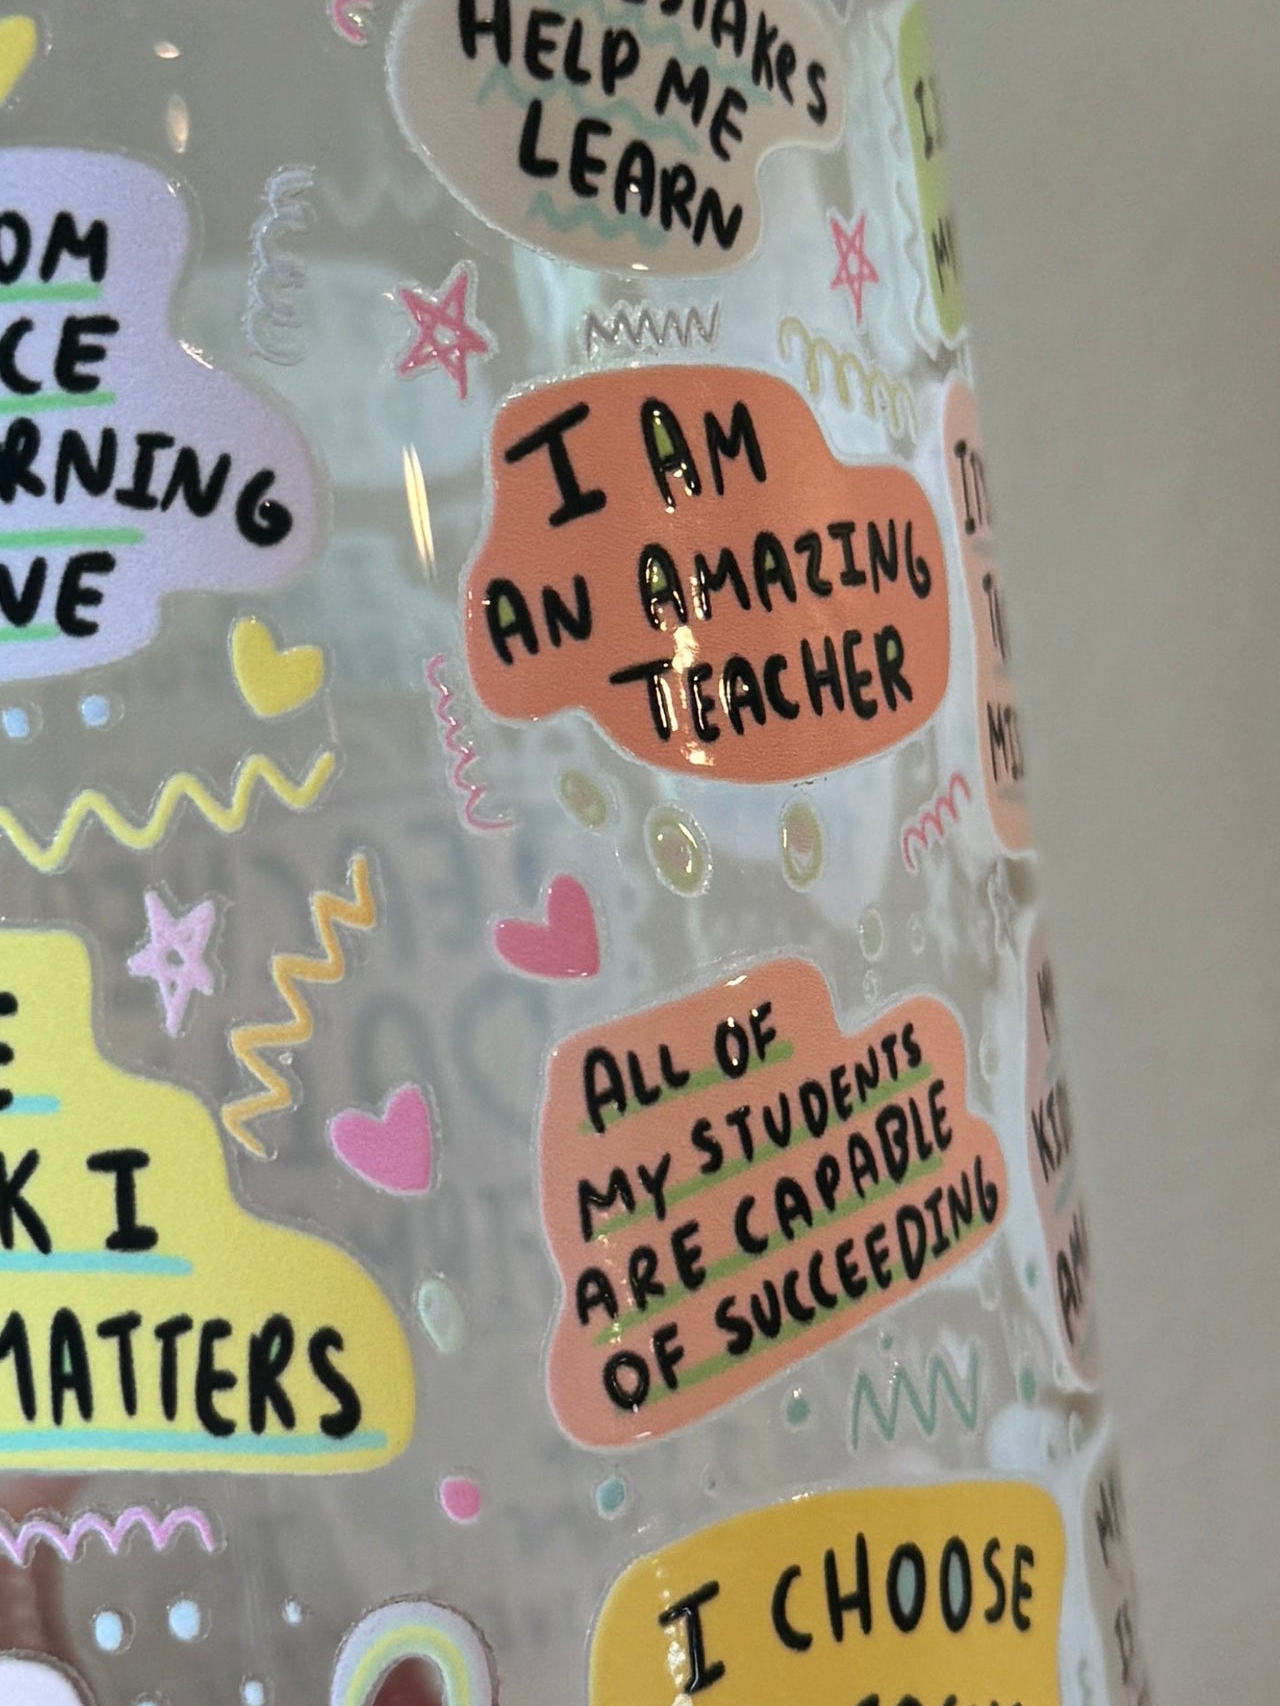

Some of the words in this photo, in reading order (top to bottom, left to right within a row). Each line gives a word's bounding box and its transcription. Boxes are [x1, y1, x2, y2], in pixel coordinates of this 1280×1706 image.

[519, 99, 743, 251] LEARN
[654, 57, 748, 162] ME
[504, 402, 608, 528] I
[641, 397, 766, 513] AM
[484, 574, 591, 665] AN
[639, 518, 931, 631] AMAZING
[610, 625, 913, 743] TEACHER
[577, 1152, 671, 1241] MY
[690, 1022, 922, 1177] STUDENTS
[582, 1044, 691, 1133] ALL
[714, 1002, 776, 1079] OF
[86, 1147, 159, 1253] I
[574, 1220, 707, 1326] ARE
[733, 1079, 953, 1254] CAPABLE
[602, 1322, 687, 1414] OF
[714, 1155, 999, 1357] SUCCEEDING
[658, 1581, 725, 1696] I
[771, 1532, 1035, 1653] CHOOSE
